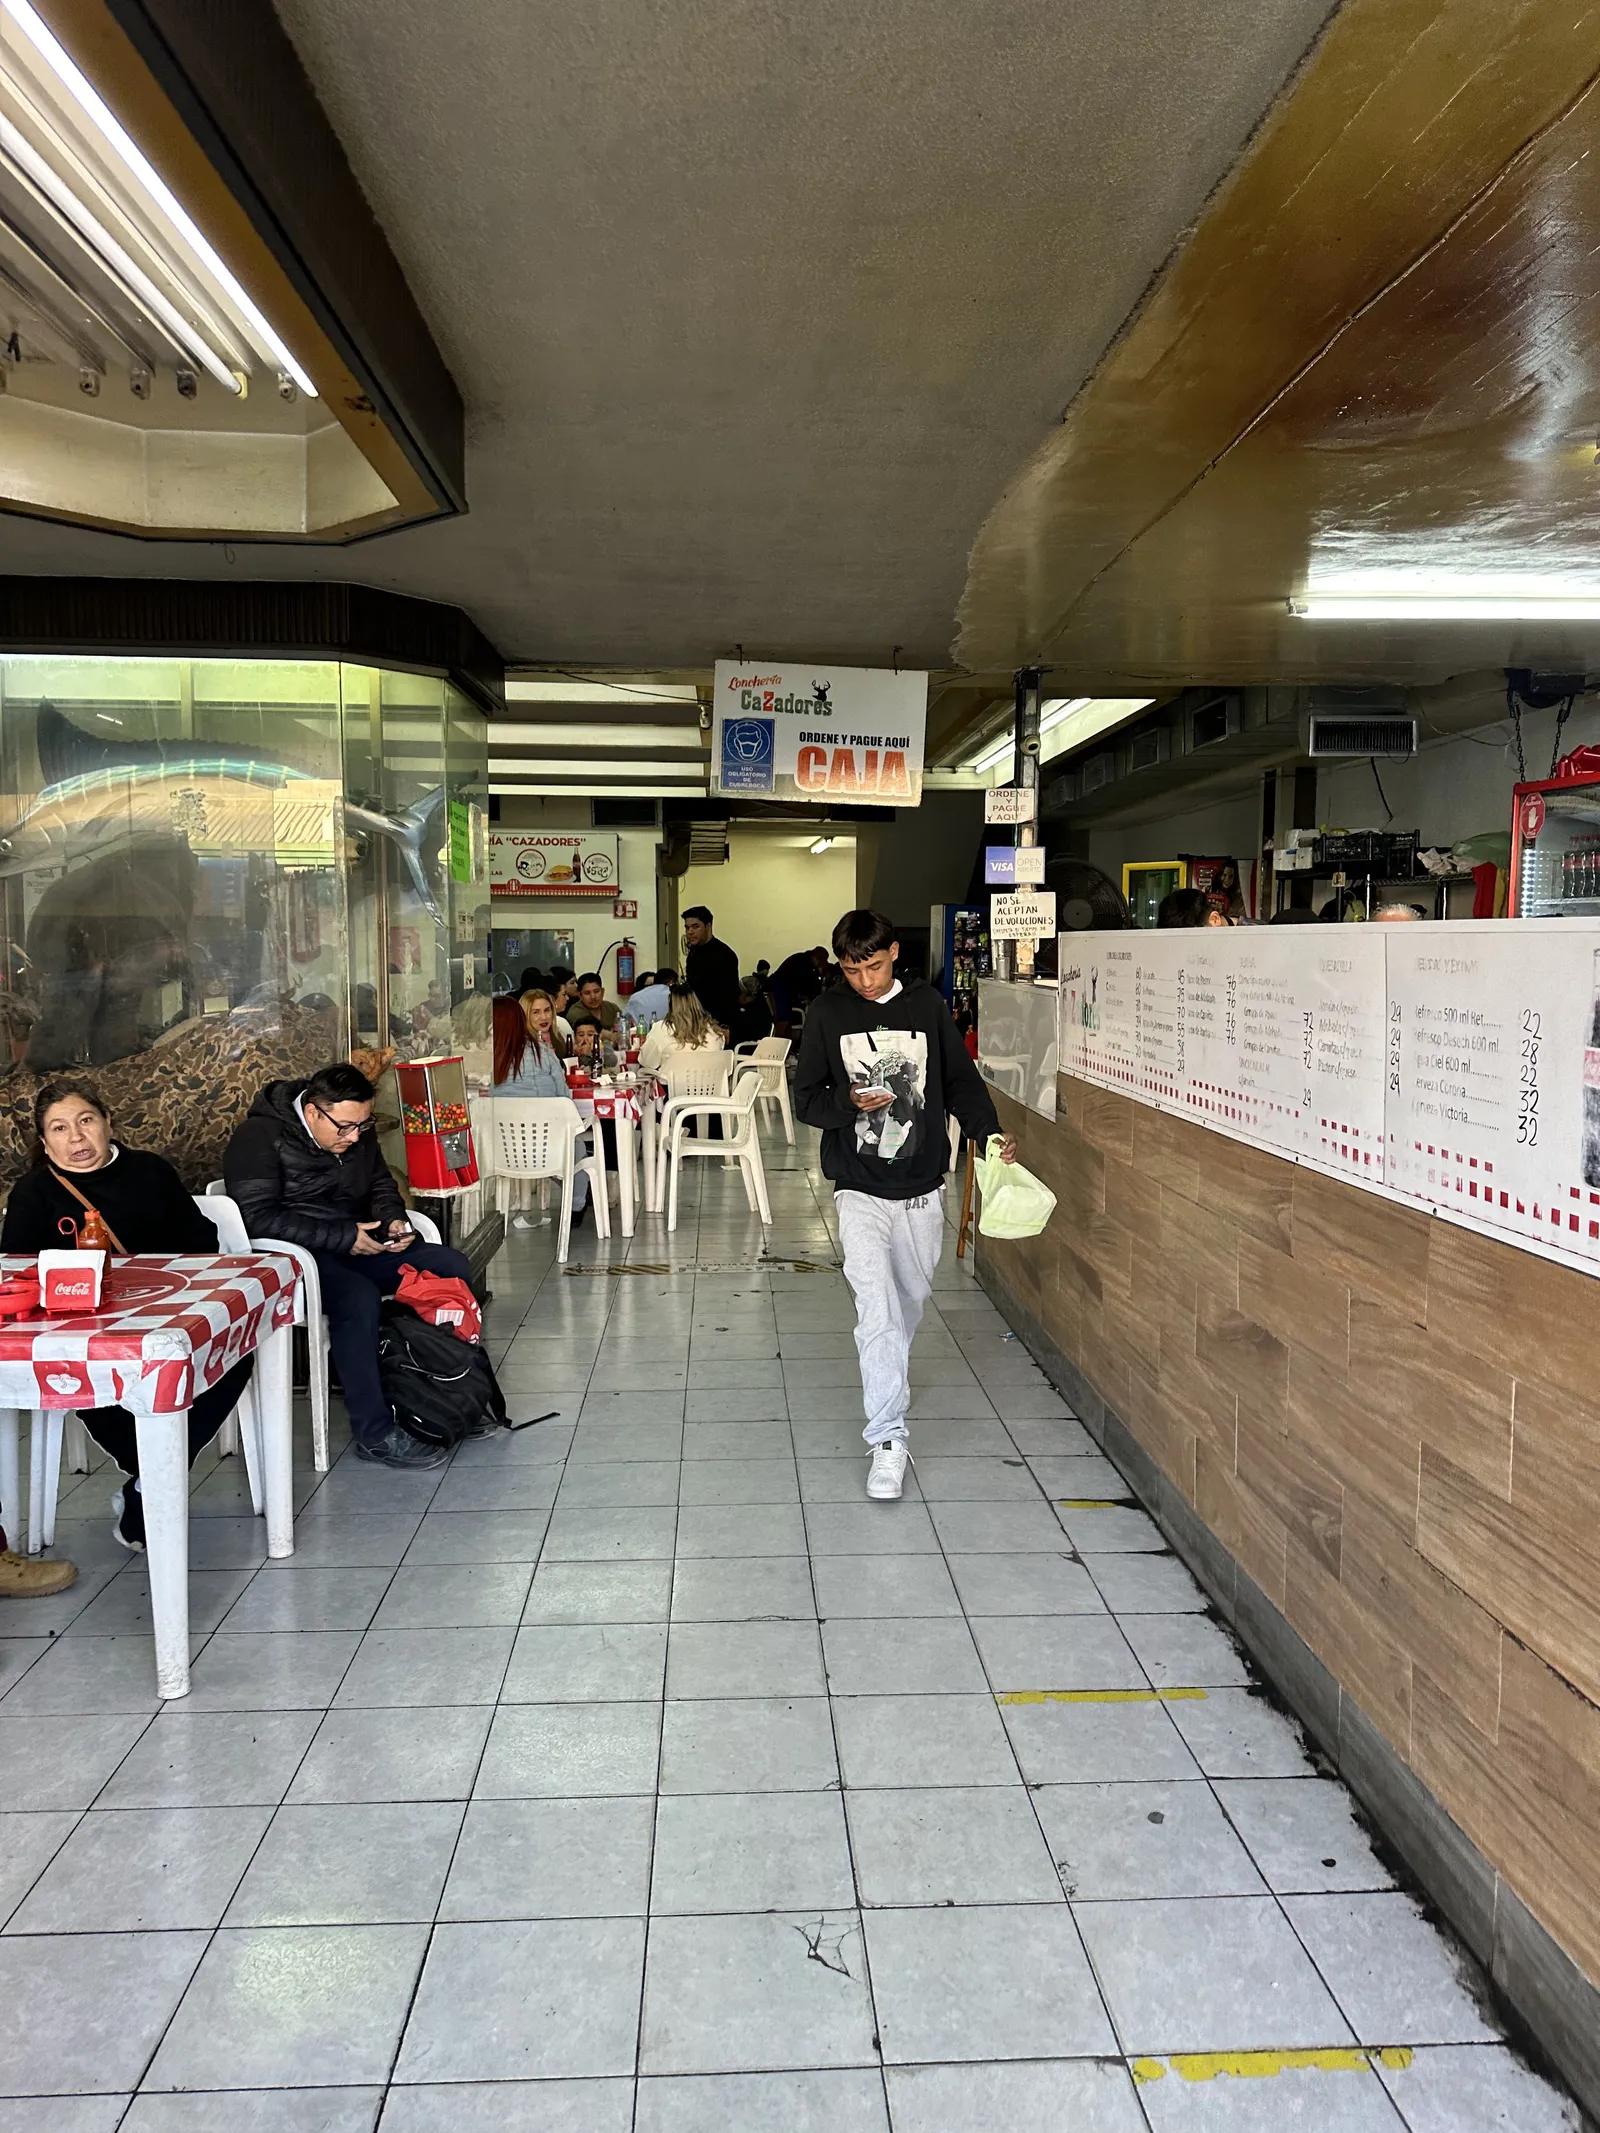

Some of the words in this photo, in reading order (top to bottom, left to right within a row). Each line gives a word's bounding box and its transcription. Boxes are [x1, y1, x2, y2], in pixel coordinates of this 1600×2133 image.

[741, 689, 833, 716] CaZadores
[799, 731, 839, 744] ORDENE
[841, 734, 848, 745] Y
[850, 735, 883, 747] PAGUE
[884, 736, 910, 748] AQUÍ
[797, 745, 911, 796] CAJA
[988, 790, 1029, 798] ORDENE
[990, 862, 1014, 872] VISA
[1017, 858, 1042, 867] OPEN
[996, 897, 1007, 906] NO
[1010, 896, 1020, 905] SE
[997, 905, 1038, 915] ACEPTAN
[994, 917, 1053, 926] DEVOLUCIONES
[1303, 1011, 1314, 1030] 72
[1391, 1000, 1402, 1023] 29
[1444, 1007, 1458, 1023] 500
[1523, 1008, 1542, 1040] 22
[1390, 1028, 1401, 1049] 29
[1390, 1050, 1400, 1072] 29
[1521, 1039, 1539, 1065] 28
[1445, 1056, 1459, 1072] 600
[1390, 1072, 1401, 1098] 29
[1520, 1064, 1537, 1088] 22
[1303, 1088, 1312, 1108] 29
[1519, 1089, 1539, 1115] 32
[1516, 1115, 1538, 1147] 32
[905, 1196, 929, 1210] GAP
